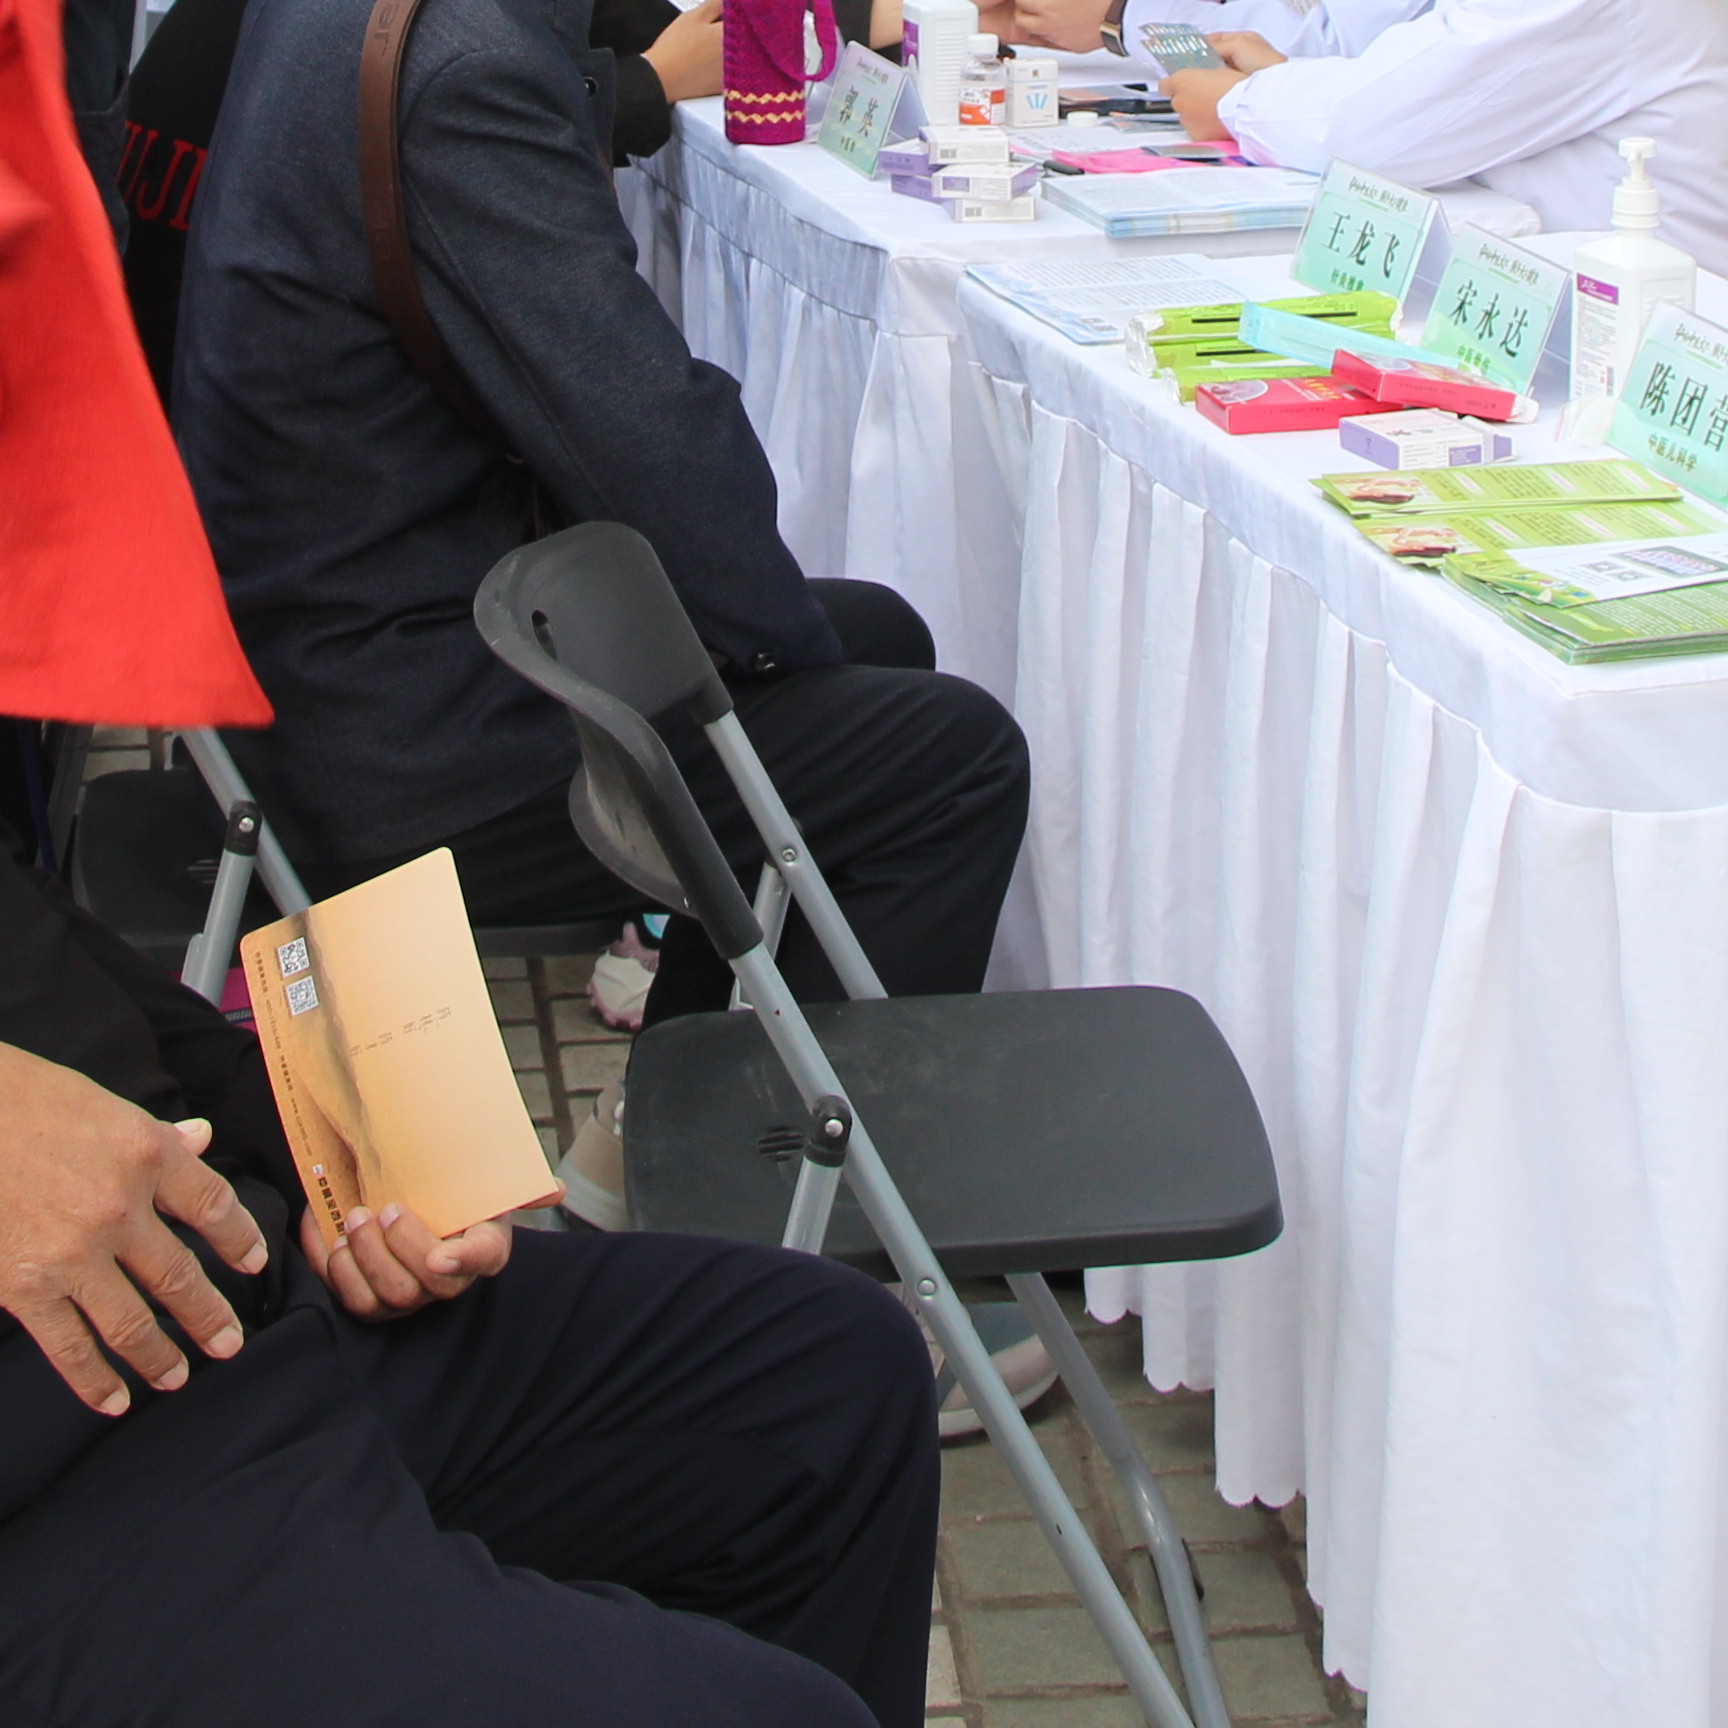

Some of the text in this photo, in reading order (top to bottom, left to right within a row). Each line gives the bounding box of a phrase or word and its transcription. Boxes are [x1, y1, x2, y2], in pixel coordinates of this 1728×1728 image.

[1320, 210, 1401, 279] 王龙飞
[1447, 278, 1529, 359] 宋永达
